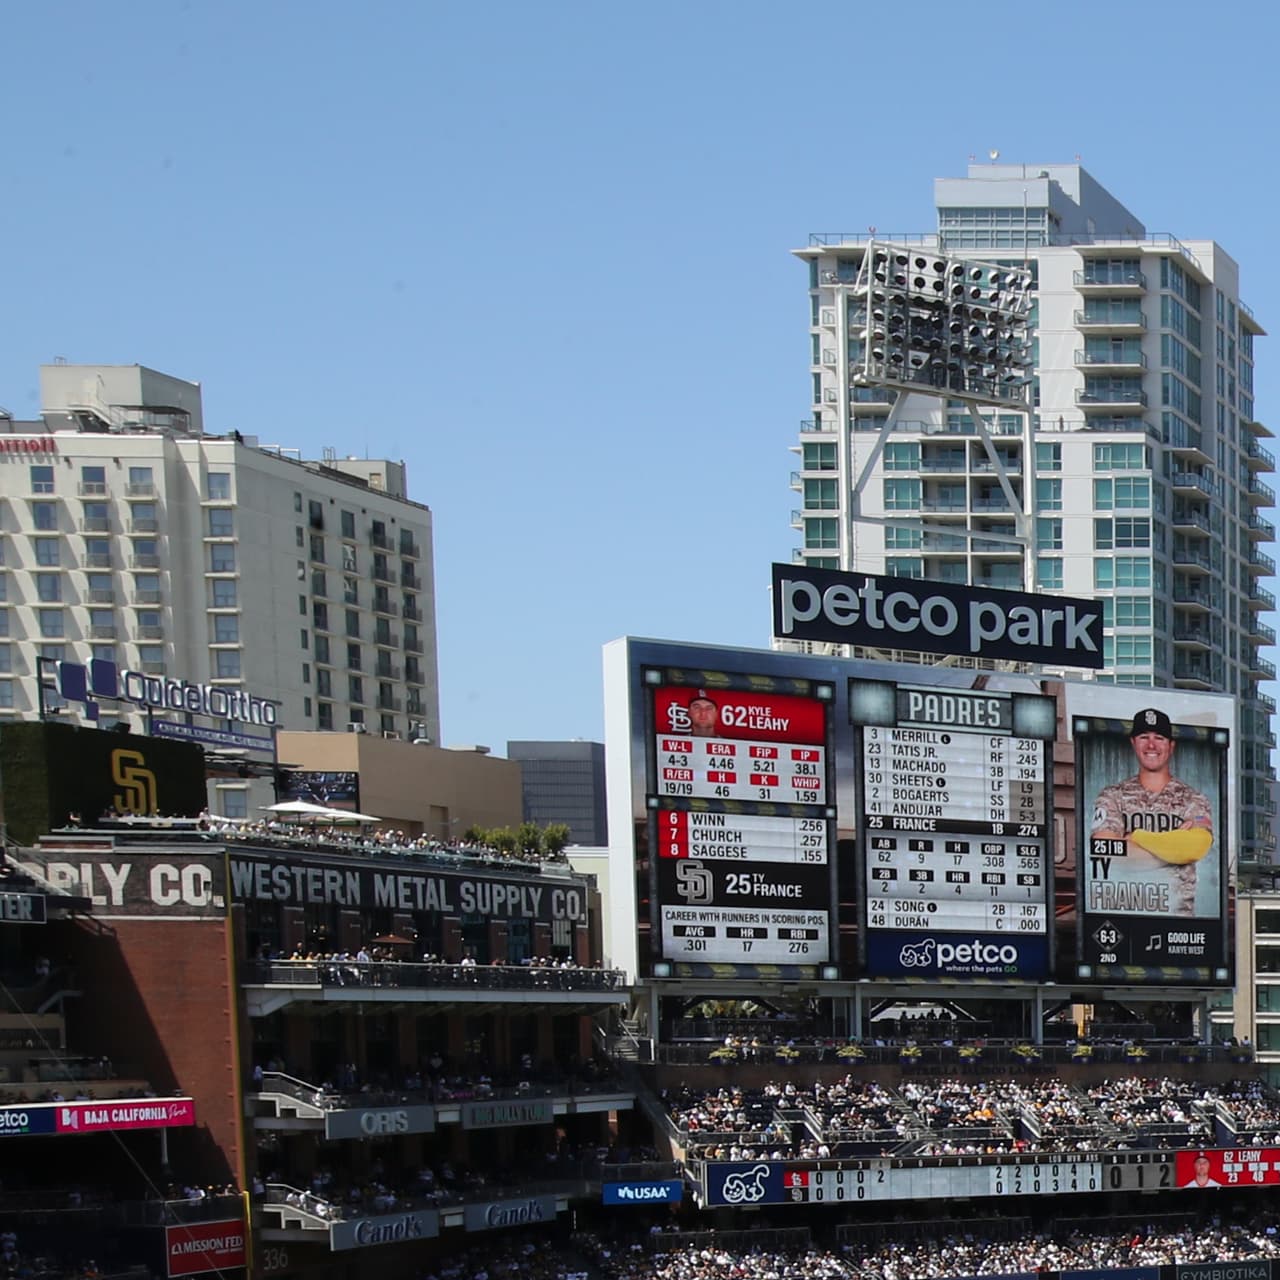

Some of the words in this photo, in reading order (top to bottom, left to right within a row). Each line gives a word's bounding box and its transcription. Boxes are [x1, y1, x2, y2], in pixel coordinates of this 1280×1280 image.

[781, 579, 958, 636] petco
[970, 601, 1098, 652] park
[121, 670, 277, 725] QuidelOrtho
[721, 705, 747, 727] 62
[749, 706, 771, 716] KYLE
[909, 692, 1000, 727] PADRES
[749, 717, 789, 731] LEAHY
[892, 730, 938, 744] MERRILL
[891, 744, 920, 757] TATIS
[923, 747, 938, 758] JR.
[892, 759, 946, 773] MACHADO
[892, 774, 933, 787] SHEETS
[892, 789, 949, 802] BOGAERTS
[892, 803, 942, 816] ANDUJAR
[692, 814, 725, 826] WINN
[893, 817, 936, 831] FRANCE
[692, 829, 742, 842] CHURCH
[692, 845, 748, 858] SAGGESE
[1090, 857, 1112, 880] TY
[150, 863, 225, 907] CO.
[230, 860, 361, 905] WESTERN
[374, 874, 454, 912] METAL
[460, 881, 542, 918] SUPPLY
[551, 889, 586, 921] CO.
[725, 874, 751, 894] 25
[752, 873, 765, 883] TY
[753, 883, 802, 897] FRANCE
[1090, 881, 1169, 912] FRANCE
[895, 902, 924, 912] SONG
[665, 910, 697, 921] CAREER
[699, 912, 719, 921] WITH
[722, 913, 760, 923] RUNNERS
[762, 914, 770, 923] IN
[772, 914, 806, 924] SCORING
[808, 917, 824, 925] POS.
[895, 915, 929, 927] DURÁN
[1168, 932, 1188, 944] GOOD
[1190, 933, 1206, 944] LIFE
[937, 940, 1017, 968] petco
[84, 1111, 109, 1124] BAJA
[112, 1107, 167, 1121] CALIFORNIA
[361, 1111, 408, 1134] ORIS
[1224, 1151, 1233, 1162] 62
[1239, 1151, 1261, 1162] LEAHY
[635, 1186, 666, 1199] USAA
[182, 1238, 224, 1253] MISSION
[225, 1236, 243, 1247] FED
[263, 1249, 288, 1270] 336
